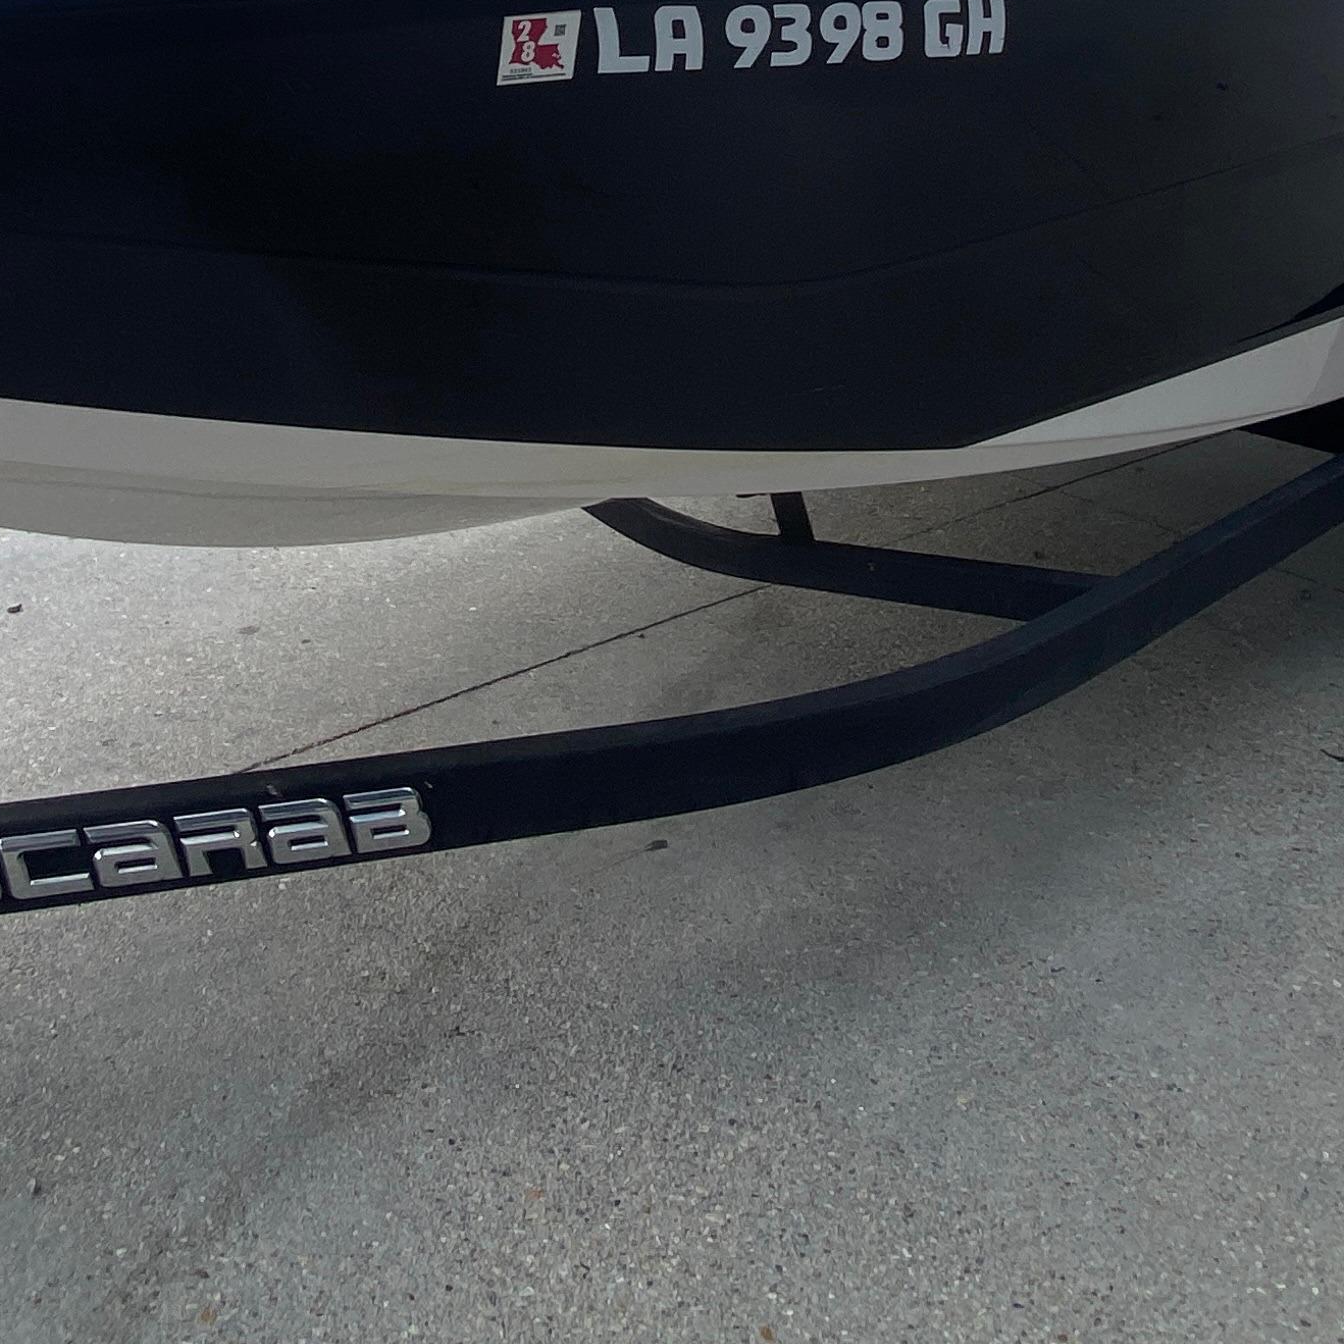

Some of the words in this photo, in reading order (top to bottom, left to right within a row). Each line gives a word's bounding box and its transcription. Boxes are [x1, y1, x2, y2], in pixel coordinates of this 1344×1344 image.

[516, 20, 533, 43] 2
[594, 5, 704, 74] LA
[725, 0, 904, 69] 9398
